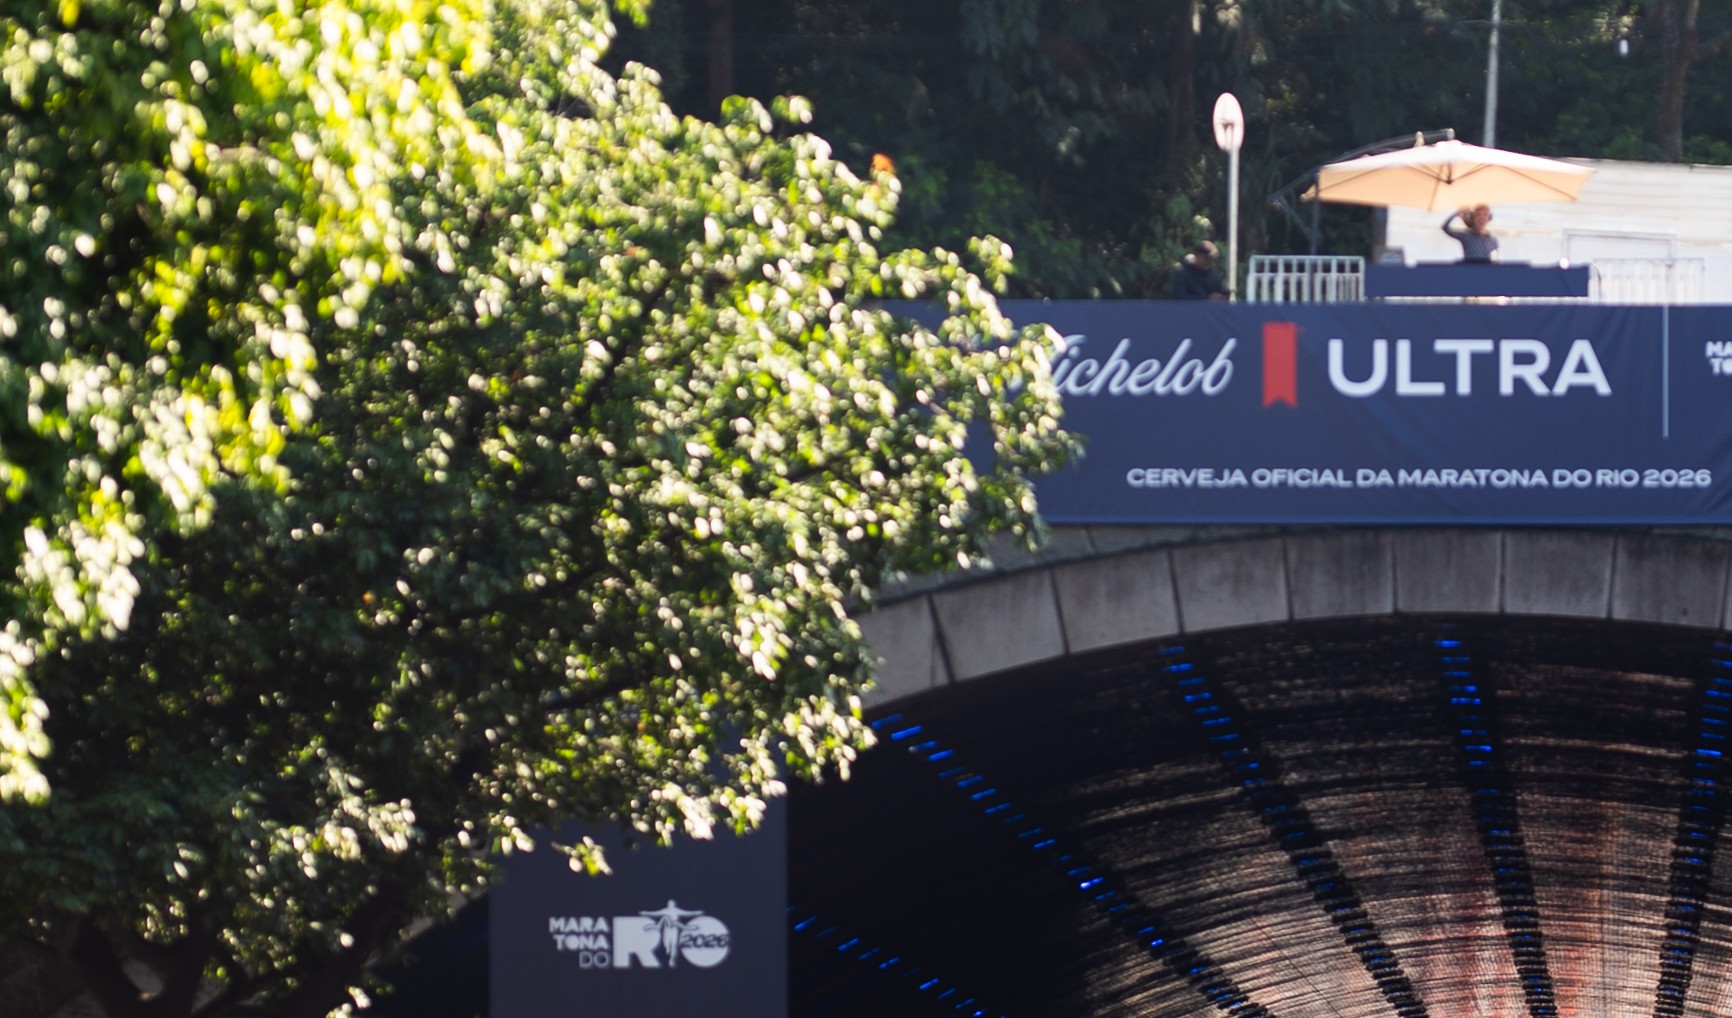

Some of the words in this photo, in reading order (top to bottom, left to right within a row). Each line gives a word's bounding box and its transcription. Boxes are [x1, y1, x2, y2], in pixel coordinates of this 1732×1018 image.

[1328, 338, 1612, 397] ULTRA
[1126, 468, 1249, 487] CERVEJA
[1252, 468, 1353, 487] OFICIAL
[1357, 468, 1395, 487] DA
[1397, 468, 1550, 487] MARATONA
[1552, 468, 1593, 487] DO
[1595, 468, 1640, 487] RIO
[1642, 468, 1712, 487] 2026
[549, 916, 610, 933] MARA
[553, 934, 609, 950] TONA
[680, 934, 730, 948] 2026
[579, 951, 609, 968] DO
